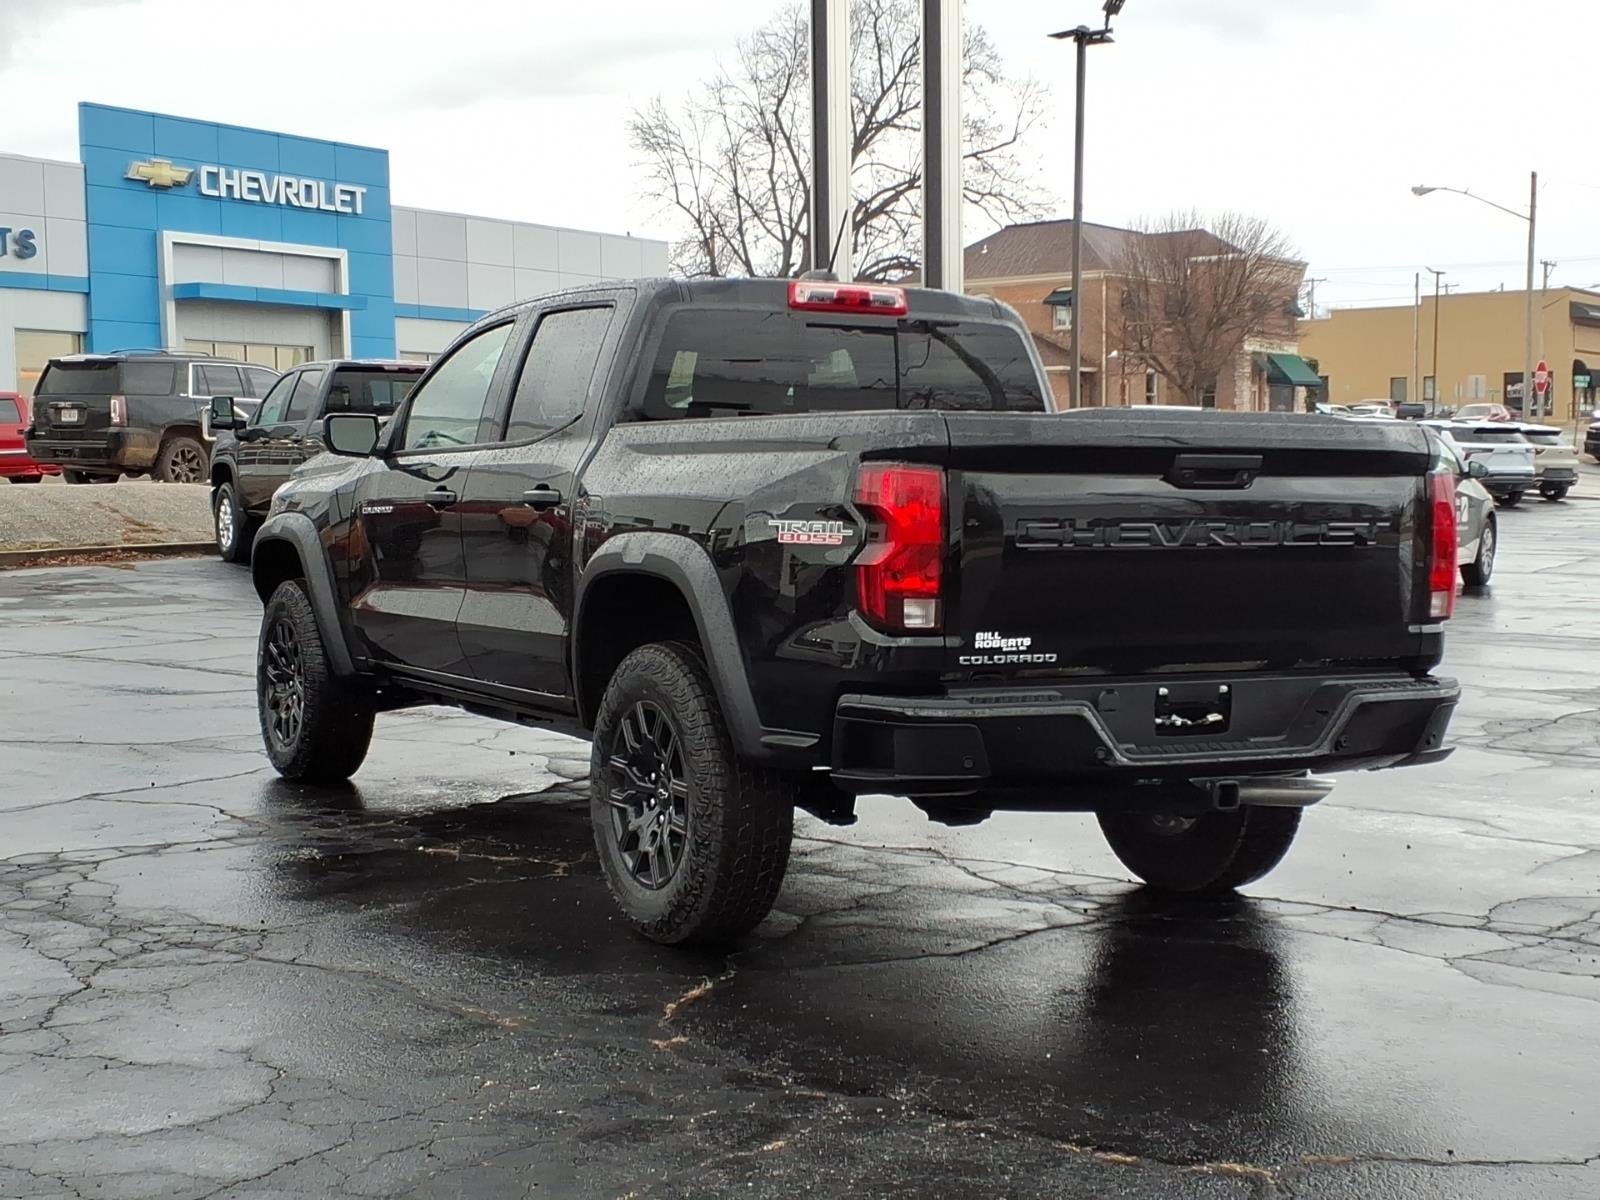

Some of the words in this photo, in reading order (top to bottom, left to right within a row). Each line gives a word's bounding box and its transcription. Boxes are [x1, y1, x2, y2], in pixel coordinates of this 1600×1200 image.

[199, 165, 367, 214] CHEVROLET
[768, 519, 853, 536] TRAIL
[1016, 518, 1391, 548] CHEVROLET
[778, 532, 843, 545] BOSS
[974, 637, 1031, 649] ROBERTS
[975, 632, 1001, 641] BILL
[959, 653, 1057, 665] COLORADO
